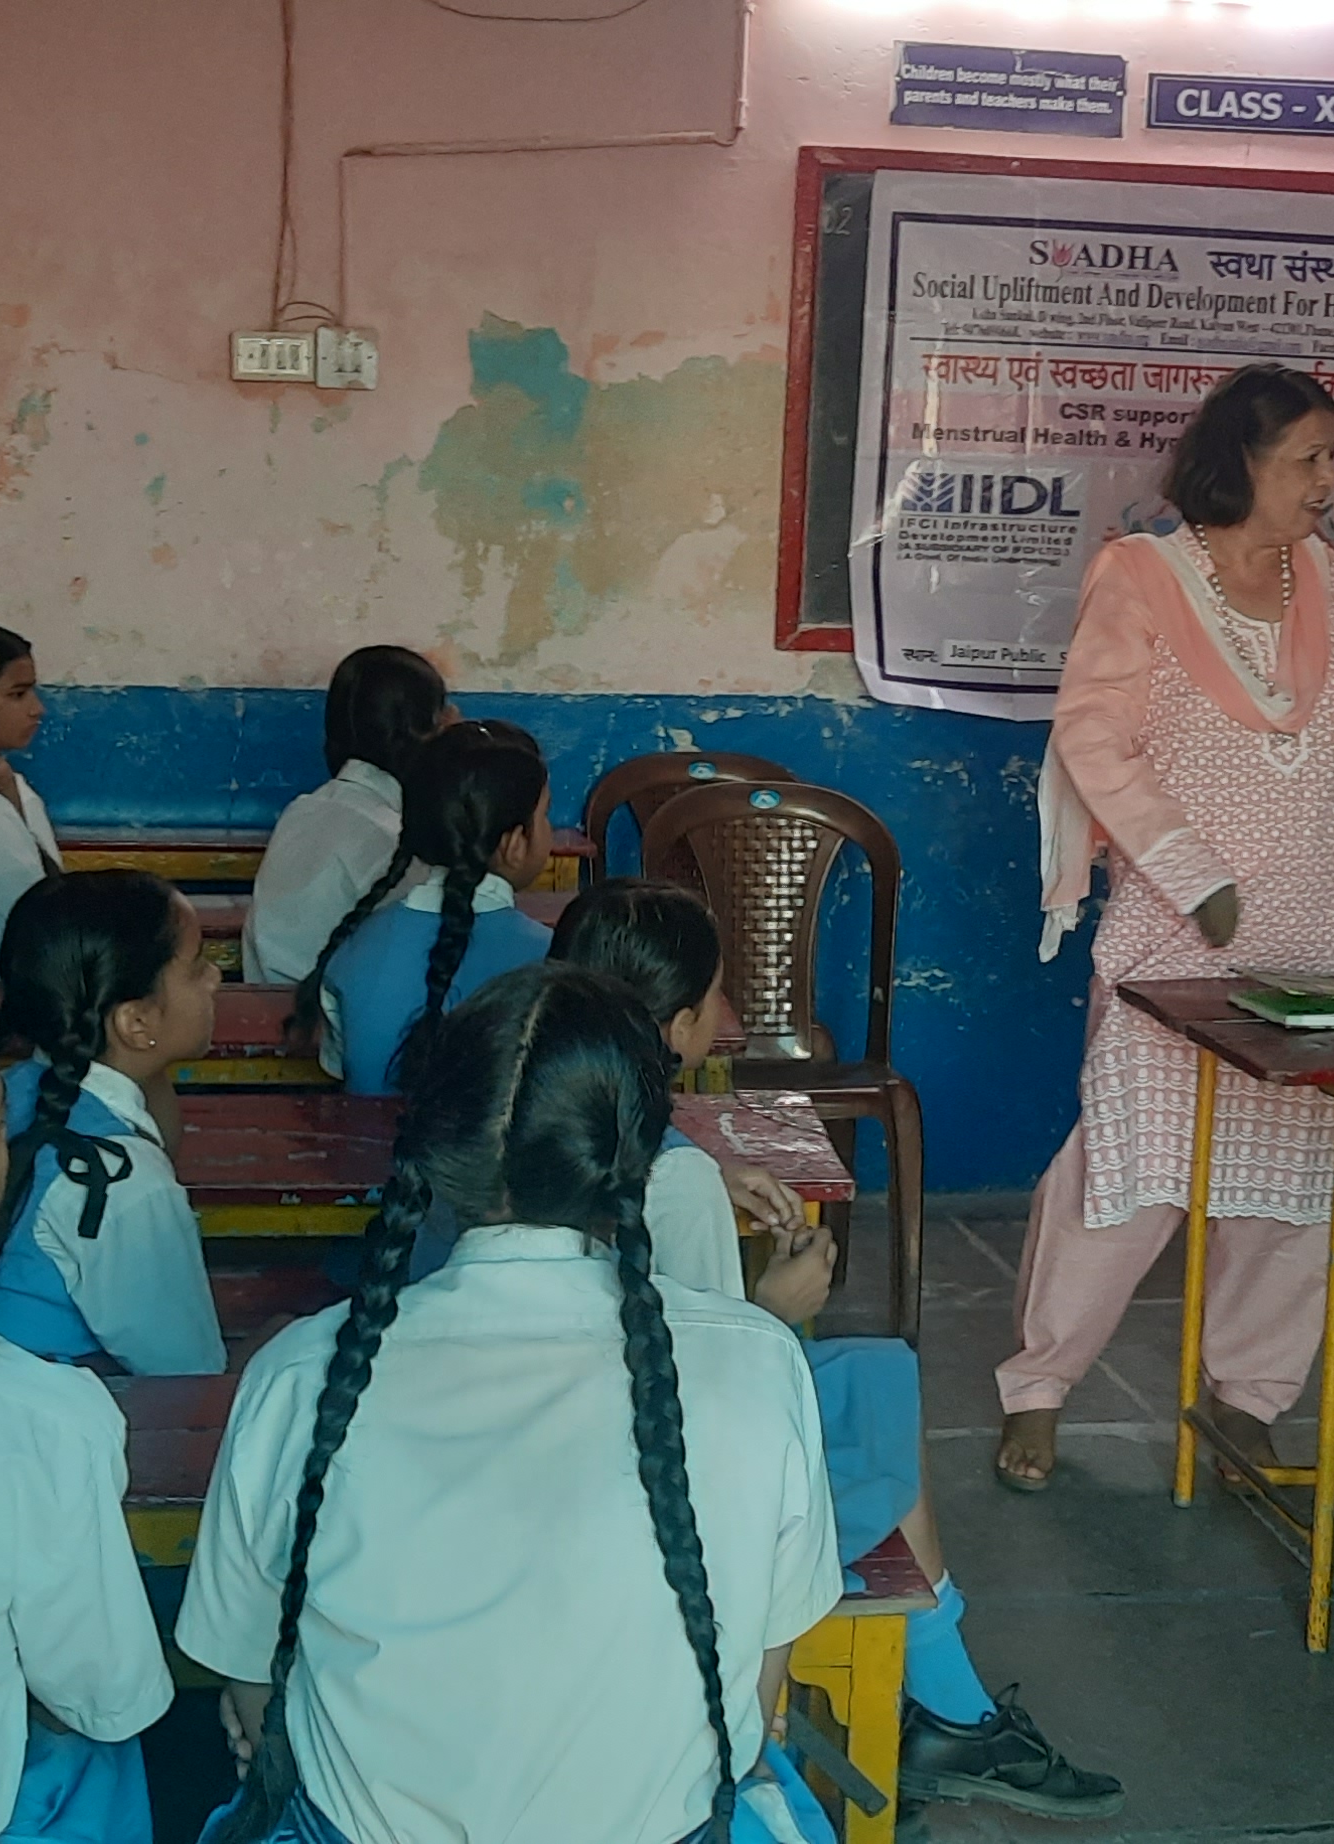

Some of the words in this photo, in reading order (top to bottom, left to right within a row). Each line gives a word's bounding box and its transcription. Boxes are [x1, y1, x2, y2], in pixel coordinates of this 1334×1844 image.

[901, 64, 954, 81] Children
[956, 67, 1007, 85] become
[1009, 71, 1053, 91] mostly
[903, 89, 953, 105] parents
[955, 90, 980, 106] and
[981, 92, 1038, 110] teachers
[1039, 96, 1075, 112] make
[1076, 98, 1113, 114] them.
[1176, 89, 1283, 122] CLASS
[1207, 251, 1276, 281] स्वधा
[913, 272, 975, 300] Social
[982, 275, 1093, 308] Upliftment
[1096, 282, 1140, 308] And
[1147, 283, 1277, 318] Development
[1282, 290, 1318, 317] For
[922, 354, 1001, 386] स्वास्थ्य
[1006, 351, 1043, 391] एवं
[1048, 359, 1137, 391] स्वच्छता
[1143, 363, 1236, 394] जागरू
[1059, 402, 1106, 421] CSR
[912, 423, 1027, 444] Menstrual
[1034, 427, 1107, 446] Health
[1114, 431, 1131, 448] &
[960, 474, 1080, 516] IIDL
[898, 531, 1006, 544] Development
[1012, 535, 1073, 546] Limited
[899, 518, 937, 529] IFCI
[944, 520, 1078, 534] Infrastructure
[950, 645, 997, 661] Jaipur
[1001, 647, 1047, 663] Public
